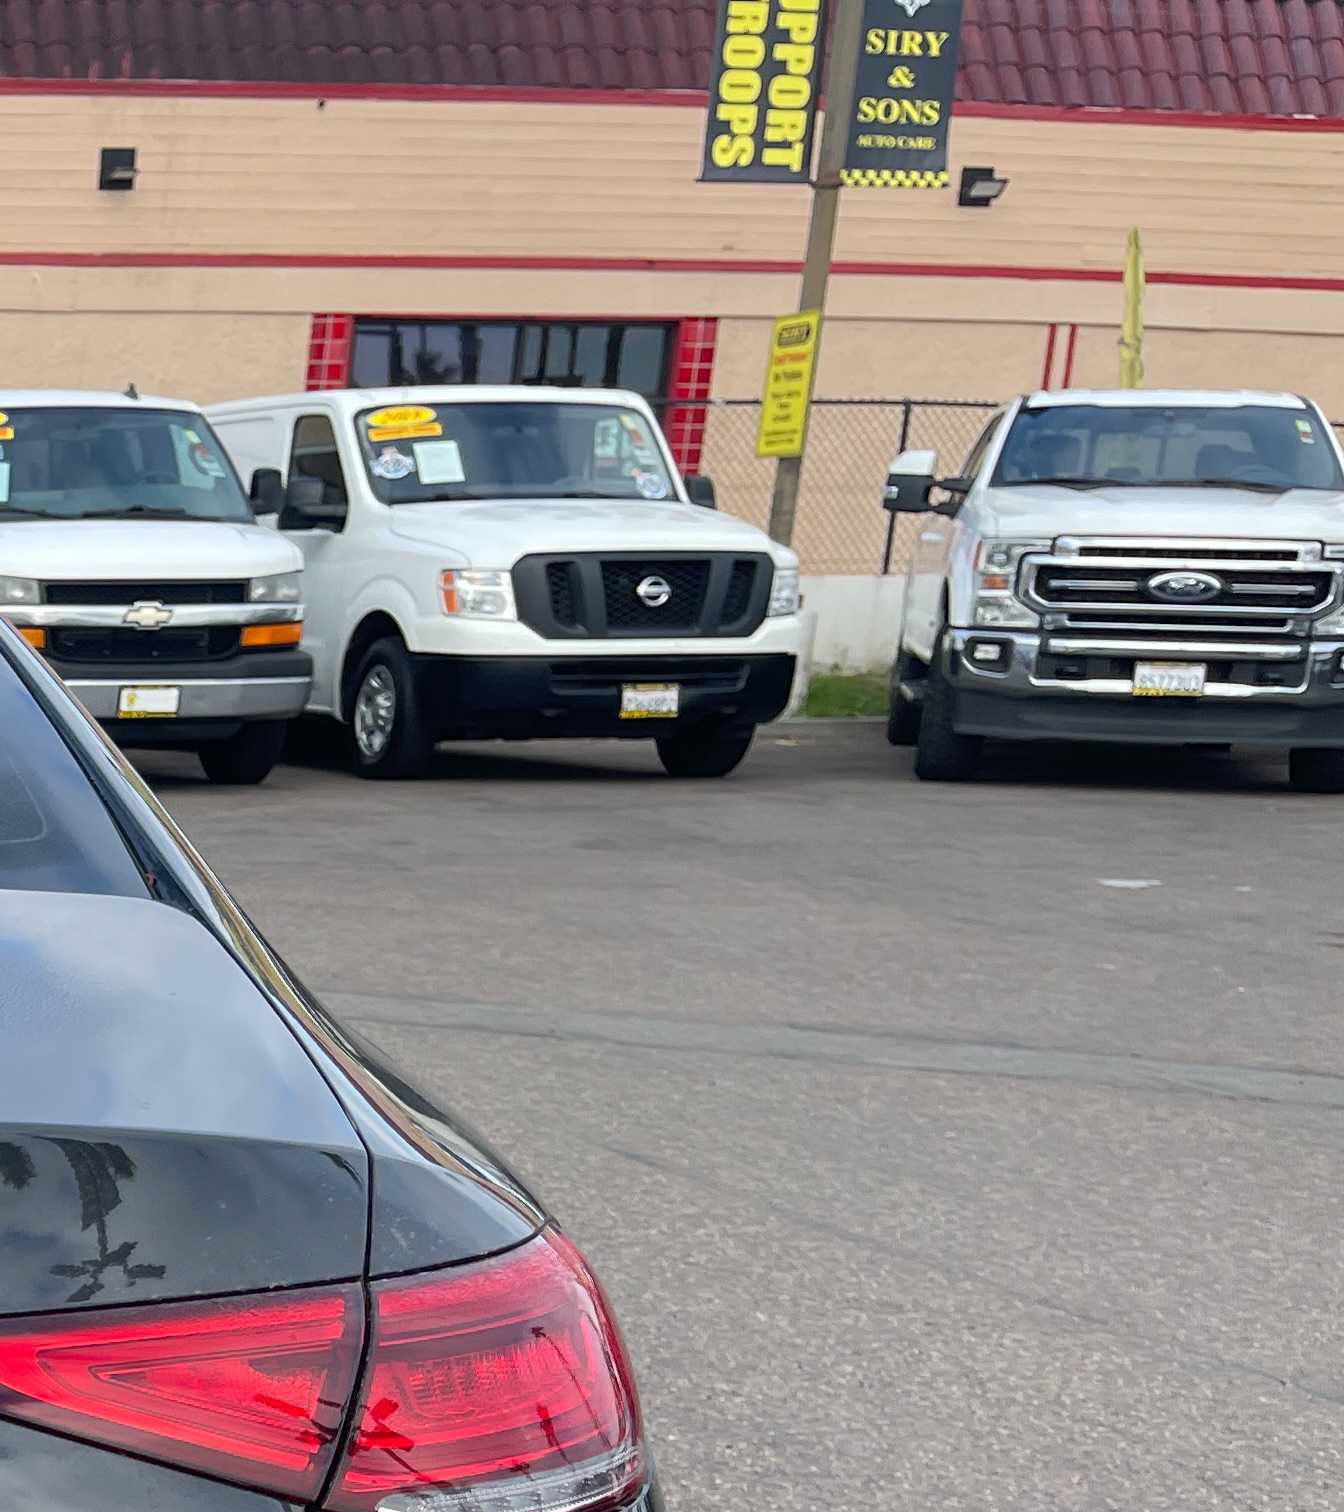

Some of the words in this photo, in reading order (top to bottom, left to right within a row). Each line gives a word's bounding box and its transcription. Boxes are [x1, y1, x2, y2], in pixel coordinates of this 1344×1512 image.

[864, 28, 951, 57] SIRY
[887, 65, 916, 88] &
[856, 97, 941, 126] SONS
